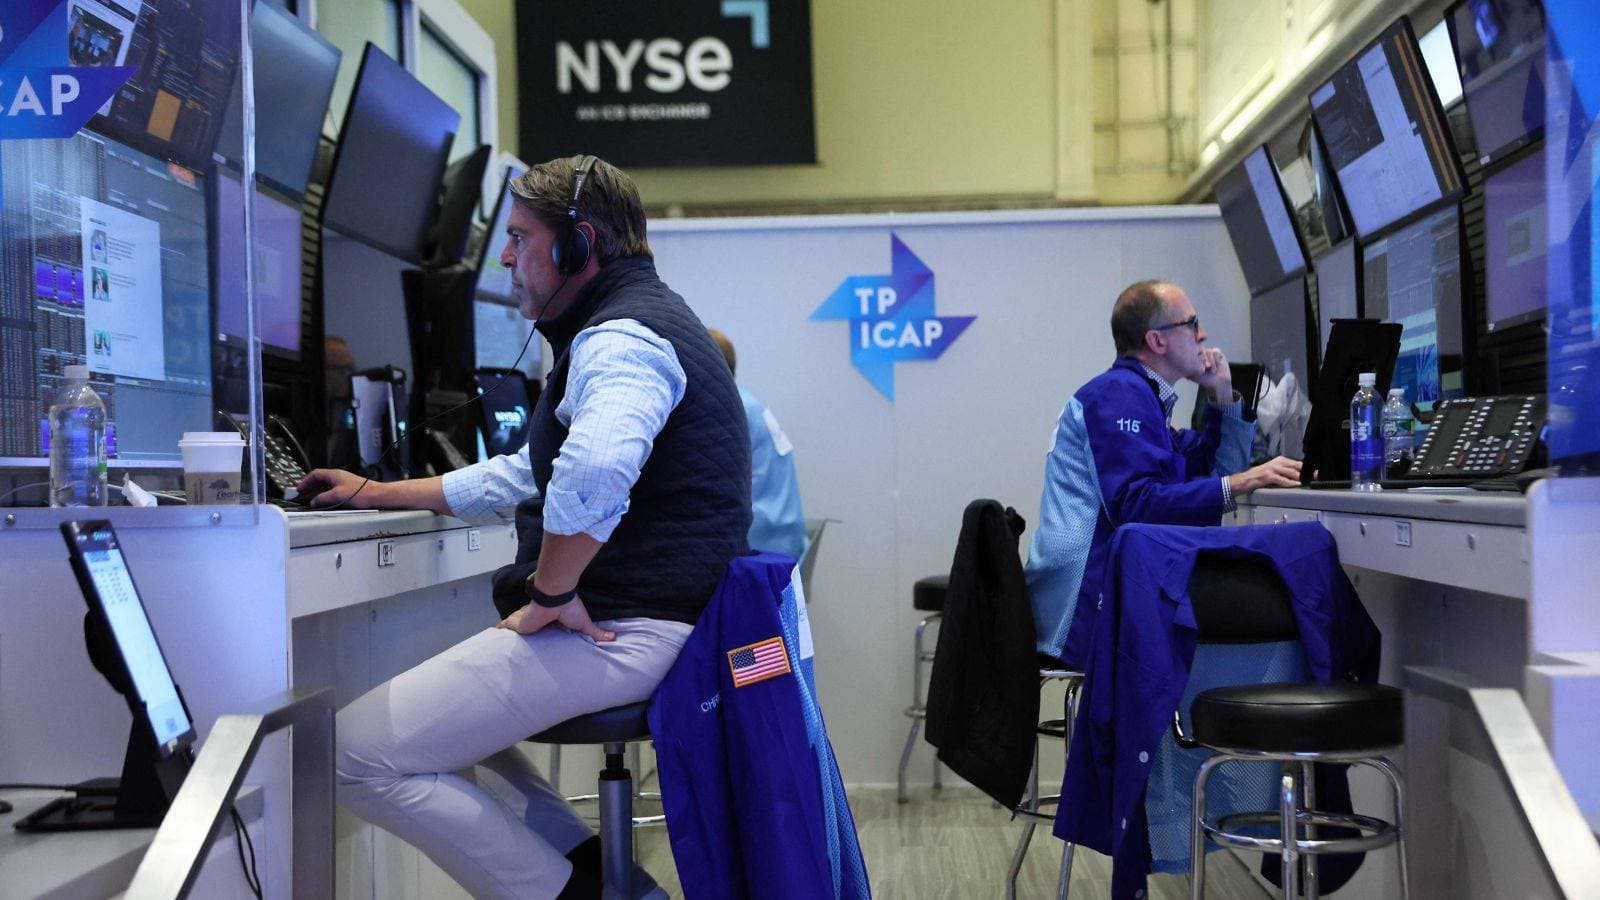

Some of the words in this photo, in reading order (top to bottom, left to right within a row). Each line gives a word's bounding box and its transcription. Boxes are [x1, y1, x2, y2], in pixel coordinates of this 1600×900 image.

[854, 287, 897, 315] TP
[861, 320, 943, 349] ICAP
[1116, 417, 1141, 433] 115
